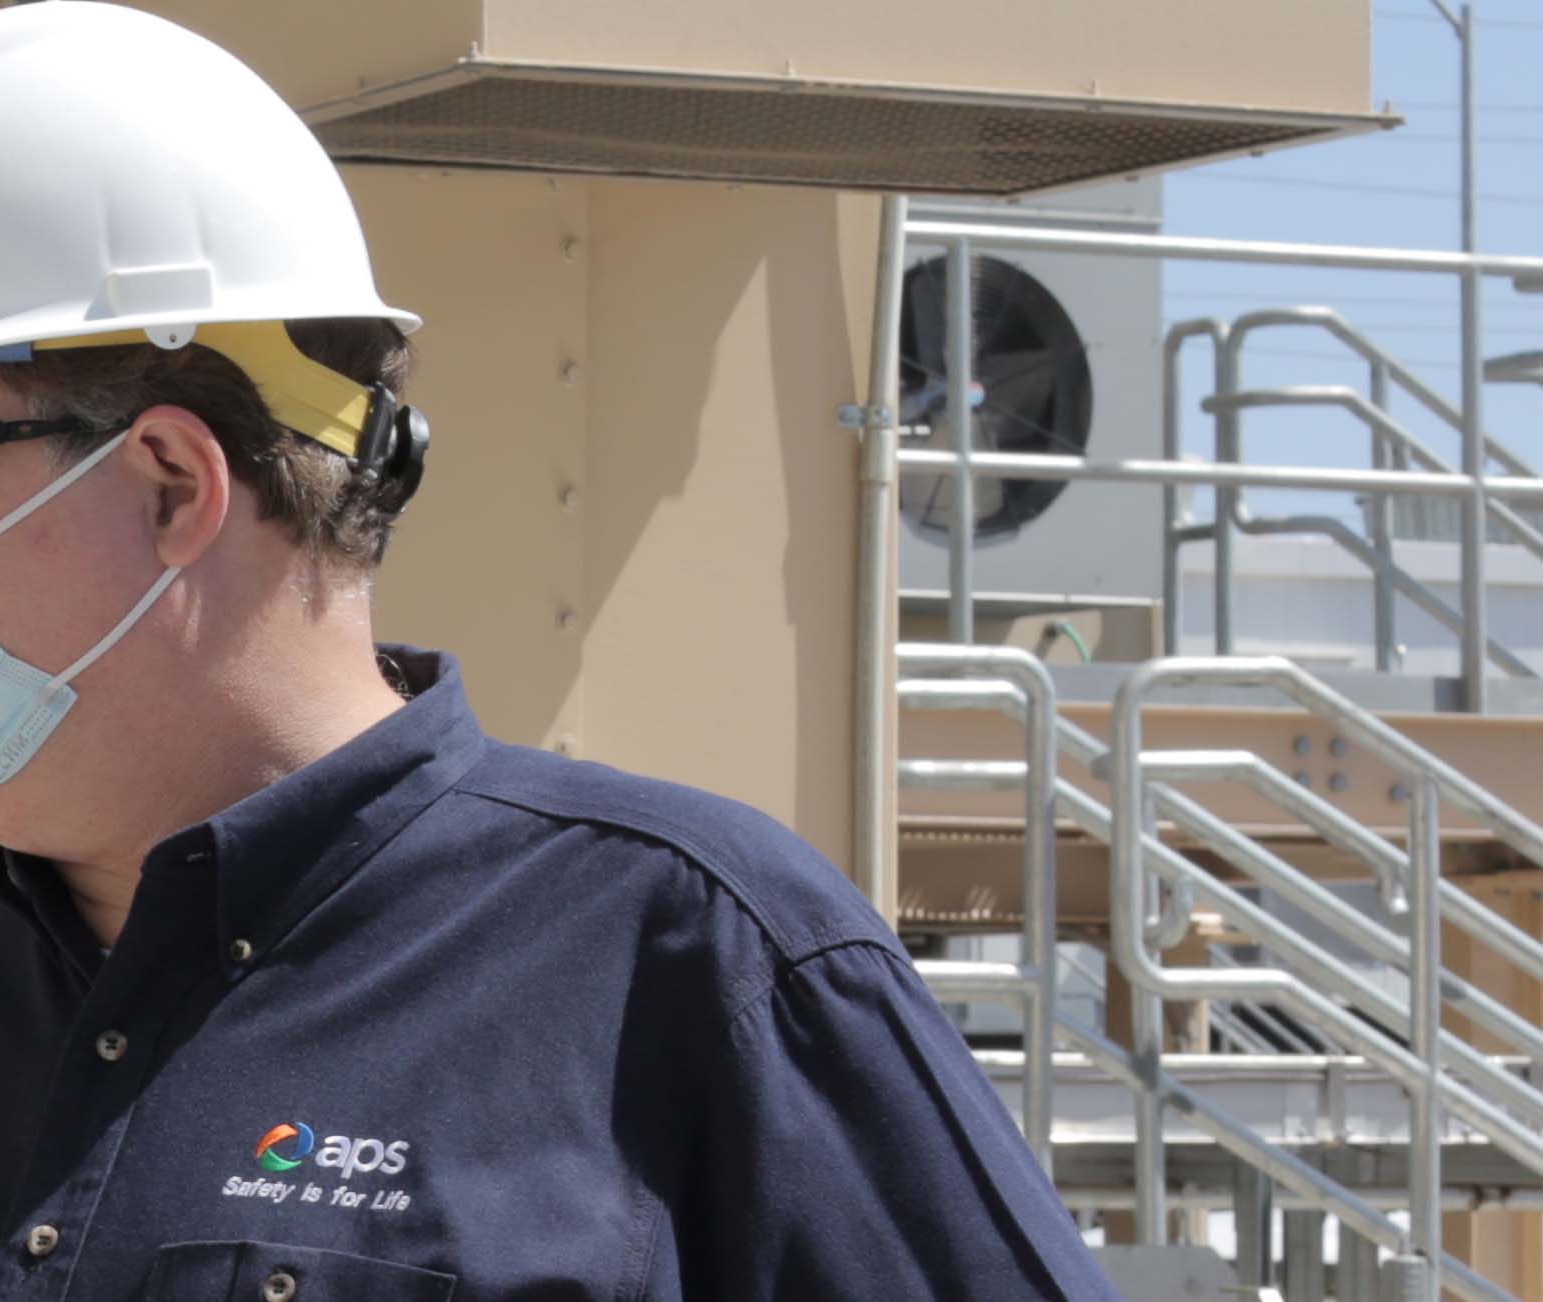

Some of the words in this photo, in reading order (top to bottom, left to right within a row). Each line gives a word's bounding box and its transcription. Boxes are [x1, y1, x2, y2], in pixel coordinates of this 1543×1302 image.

[315, 1134, 410, 1180] aps
[222, 1175, 296, 1204] Safety
[300, 1181, 323, 1203] is
[329, 1185, 367, 1208] for
[370, 1189, 412, 1212] Life
